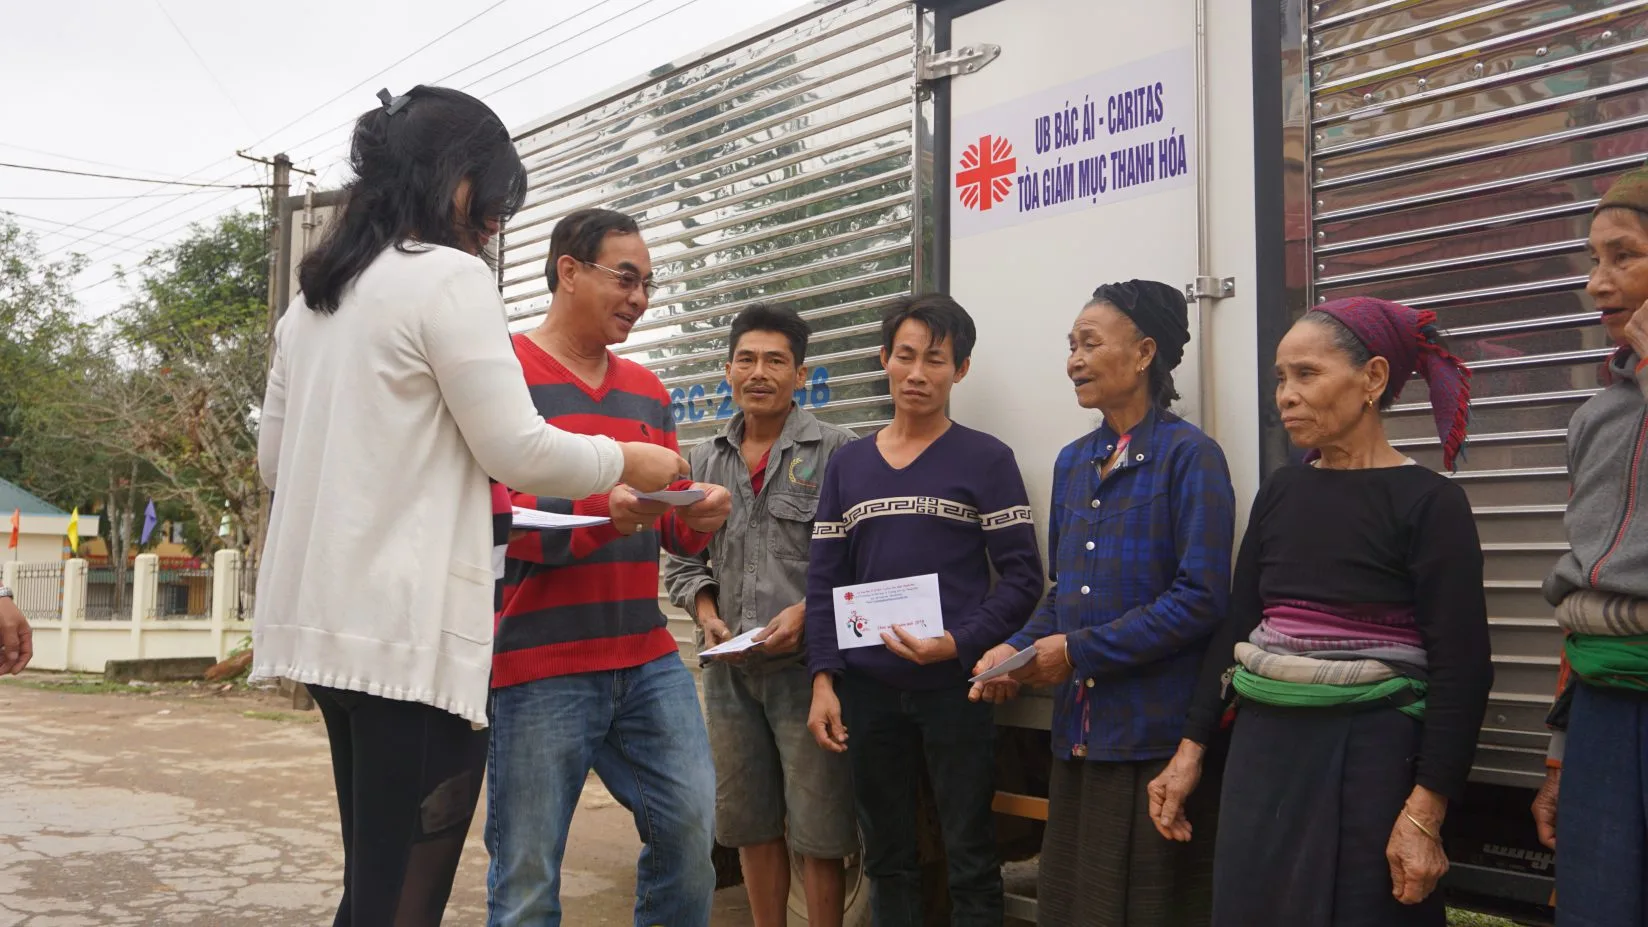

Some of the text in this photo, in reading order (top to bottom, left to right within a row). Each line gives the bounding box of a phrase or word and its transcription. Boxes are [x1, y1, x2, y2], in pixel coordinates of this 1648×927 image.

[1035, 115, 1051, 155] UB
[1055, 100, 1079, 150] BÁC
[1083, 94, 1095, 142] ÁI
[1108, 81, 1164, 135] CARITAS
[1017, 126, 1188, 212] TÒA GIÁM MỤC THANH HÓA
